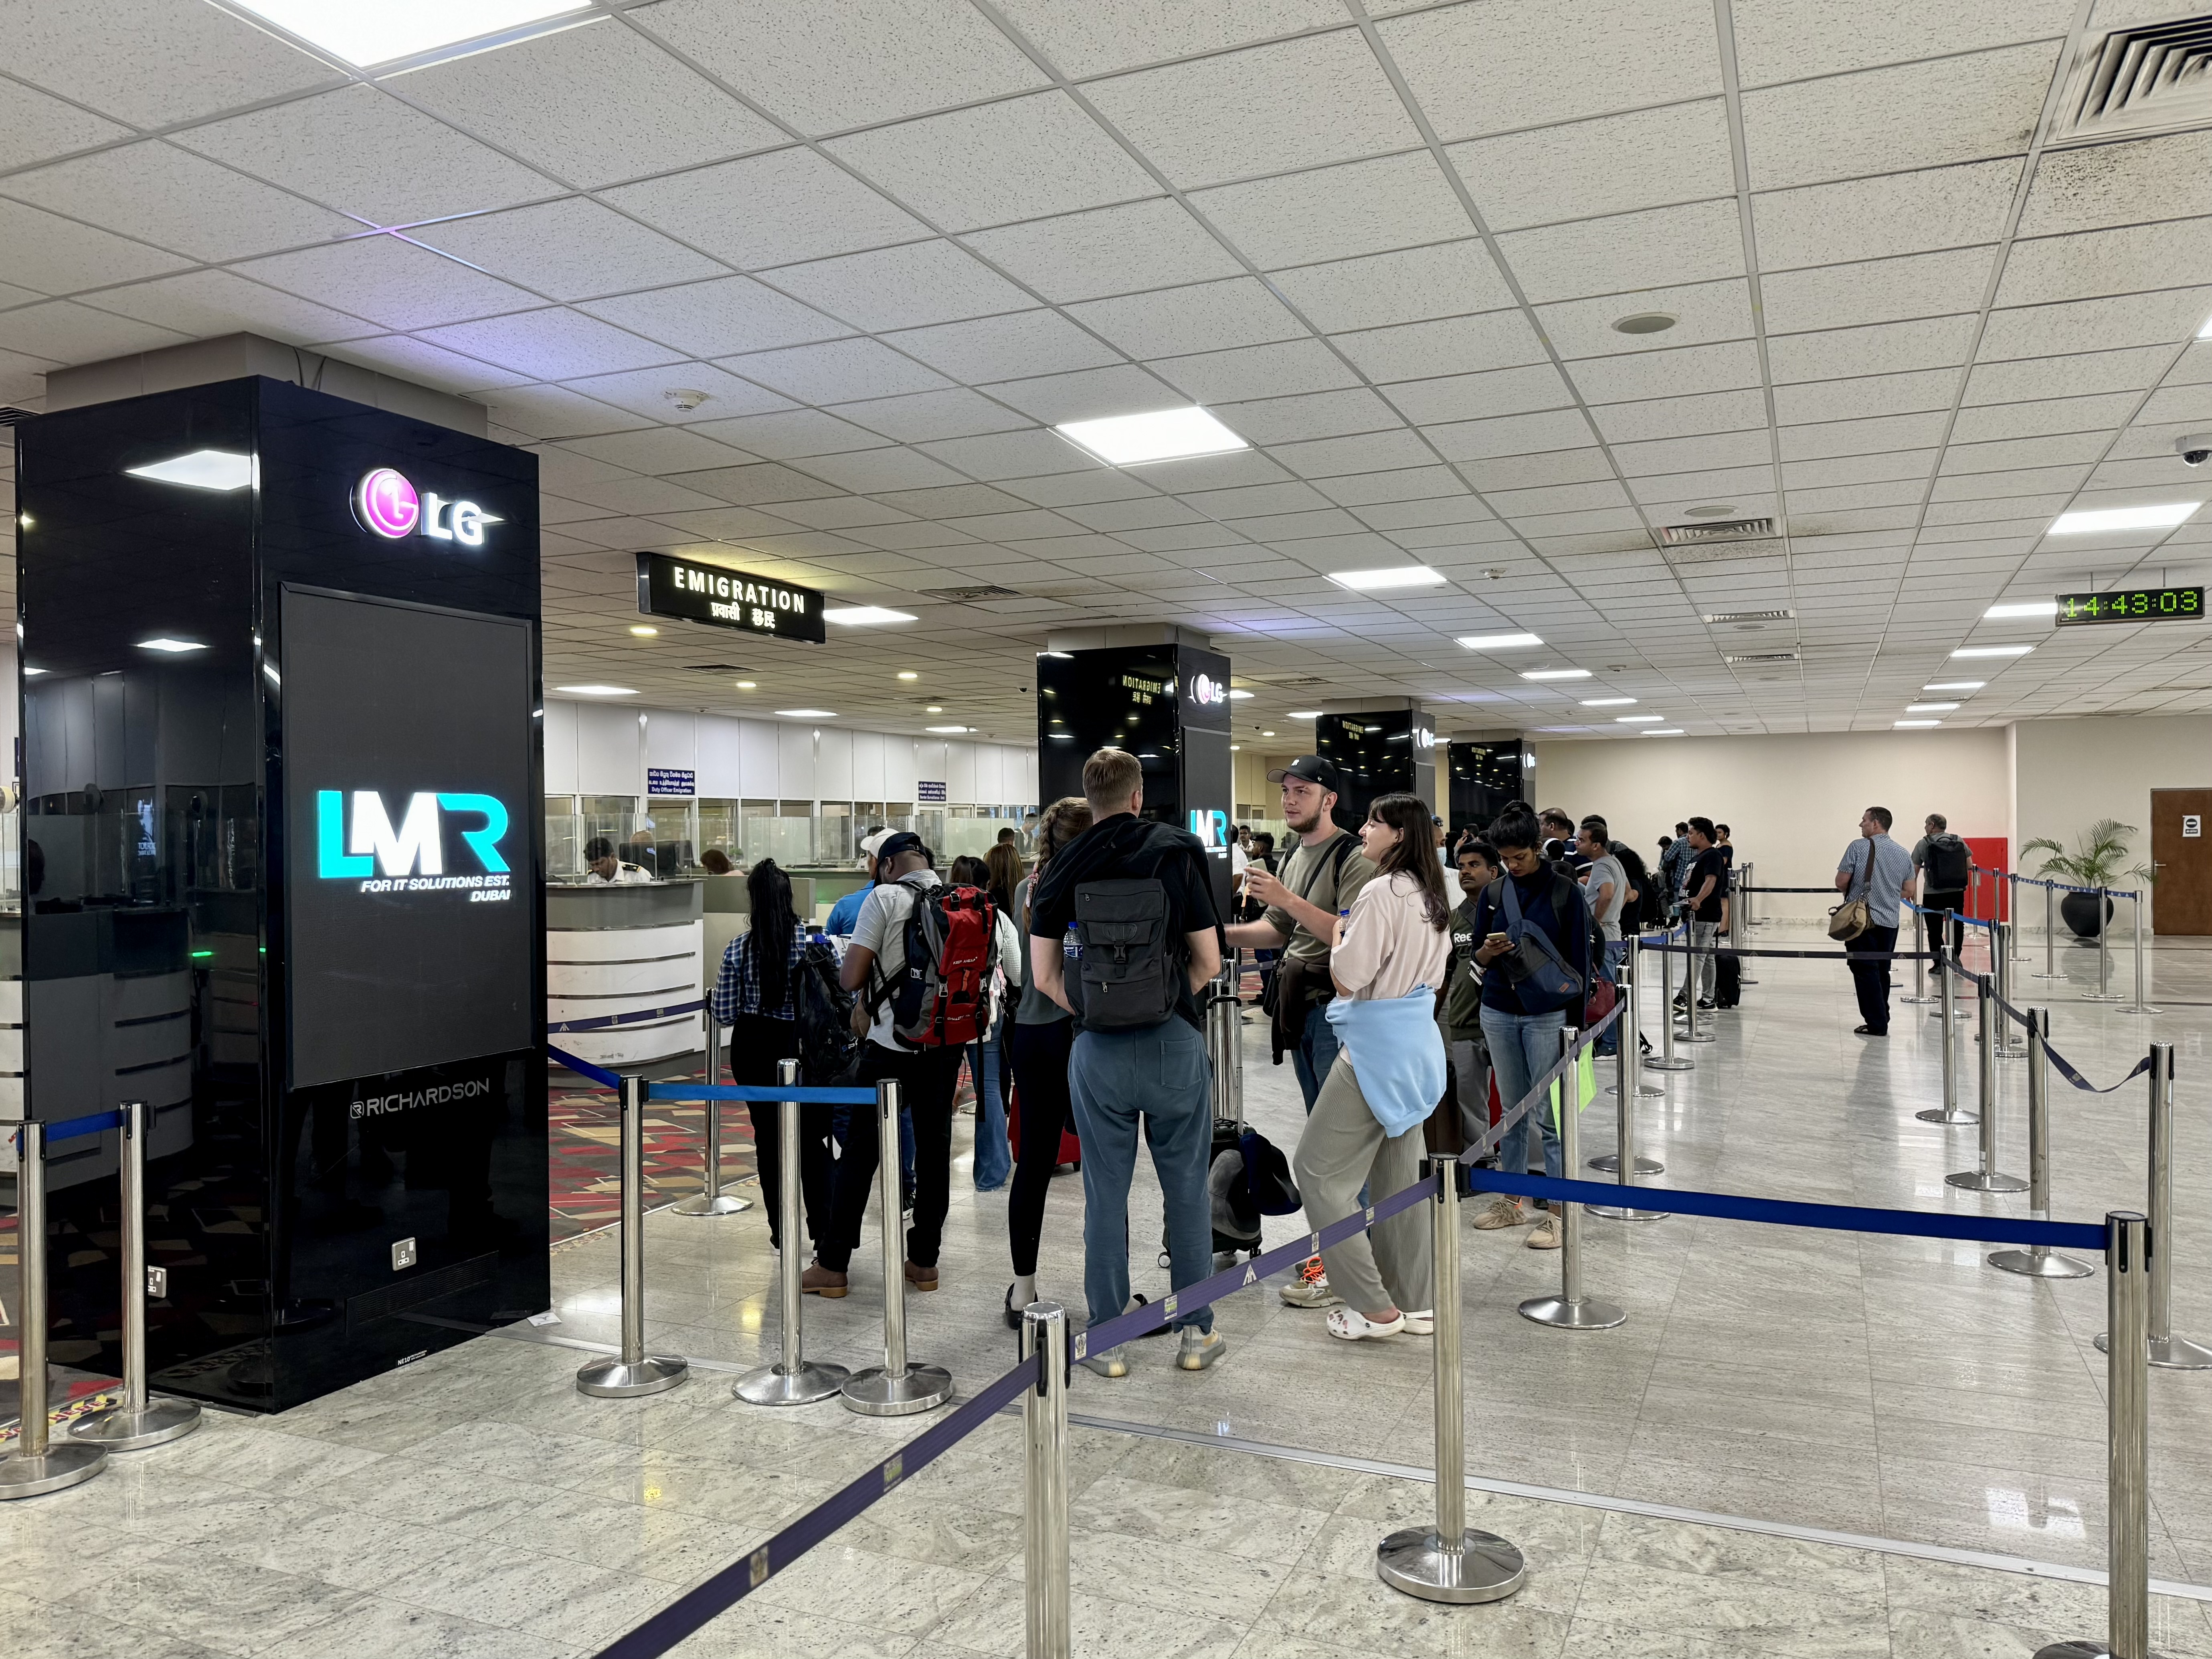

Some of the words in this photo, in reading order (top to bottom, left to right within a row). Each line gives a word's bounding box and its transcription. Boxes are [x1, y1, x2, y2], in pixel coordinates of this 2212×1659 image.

[421, 492, 483, 545] LG
[674, 566, 805, 614] EMIGRATION
[710, 601, 740, 621] प्रवासी
[2067, 591, 2198, 617] 14:43:03
[1210, 681, 1223, 703] LG
[319, 790, 511, 878] LMR
[361, 880, 392, 892] FOR
[393, 879, 408, 891] IT
[408, 876, 483, 890] SOLUTIONS
[484, 875, 510, 886] EST.
[470, 889, 511, 902] DUBAI
[1454, 933, 1472, 943] Ree
[367, 1078, 489, 1117] RICHARDSON
[398, 1356, 410, 1366] NE10
